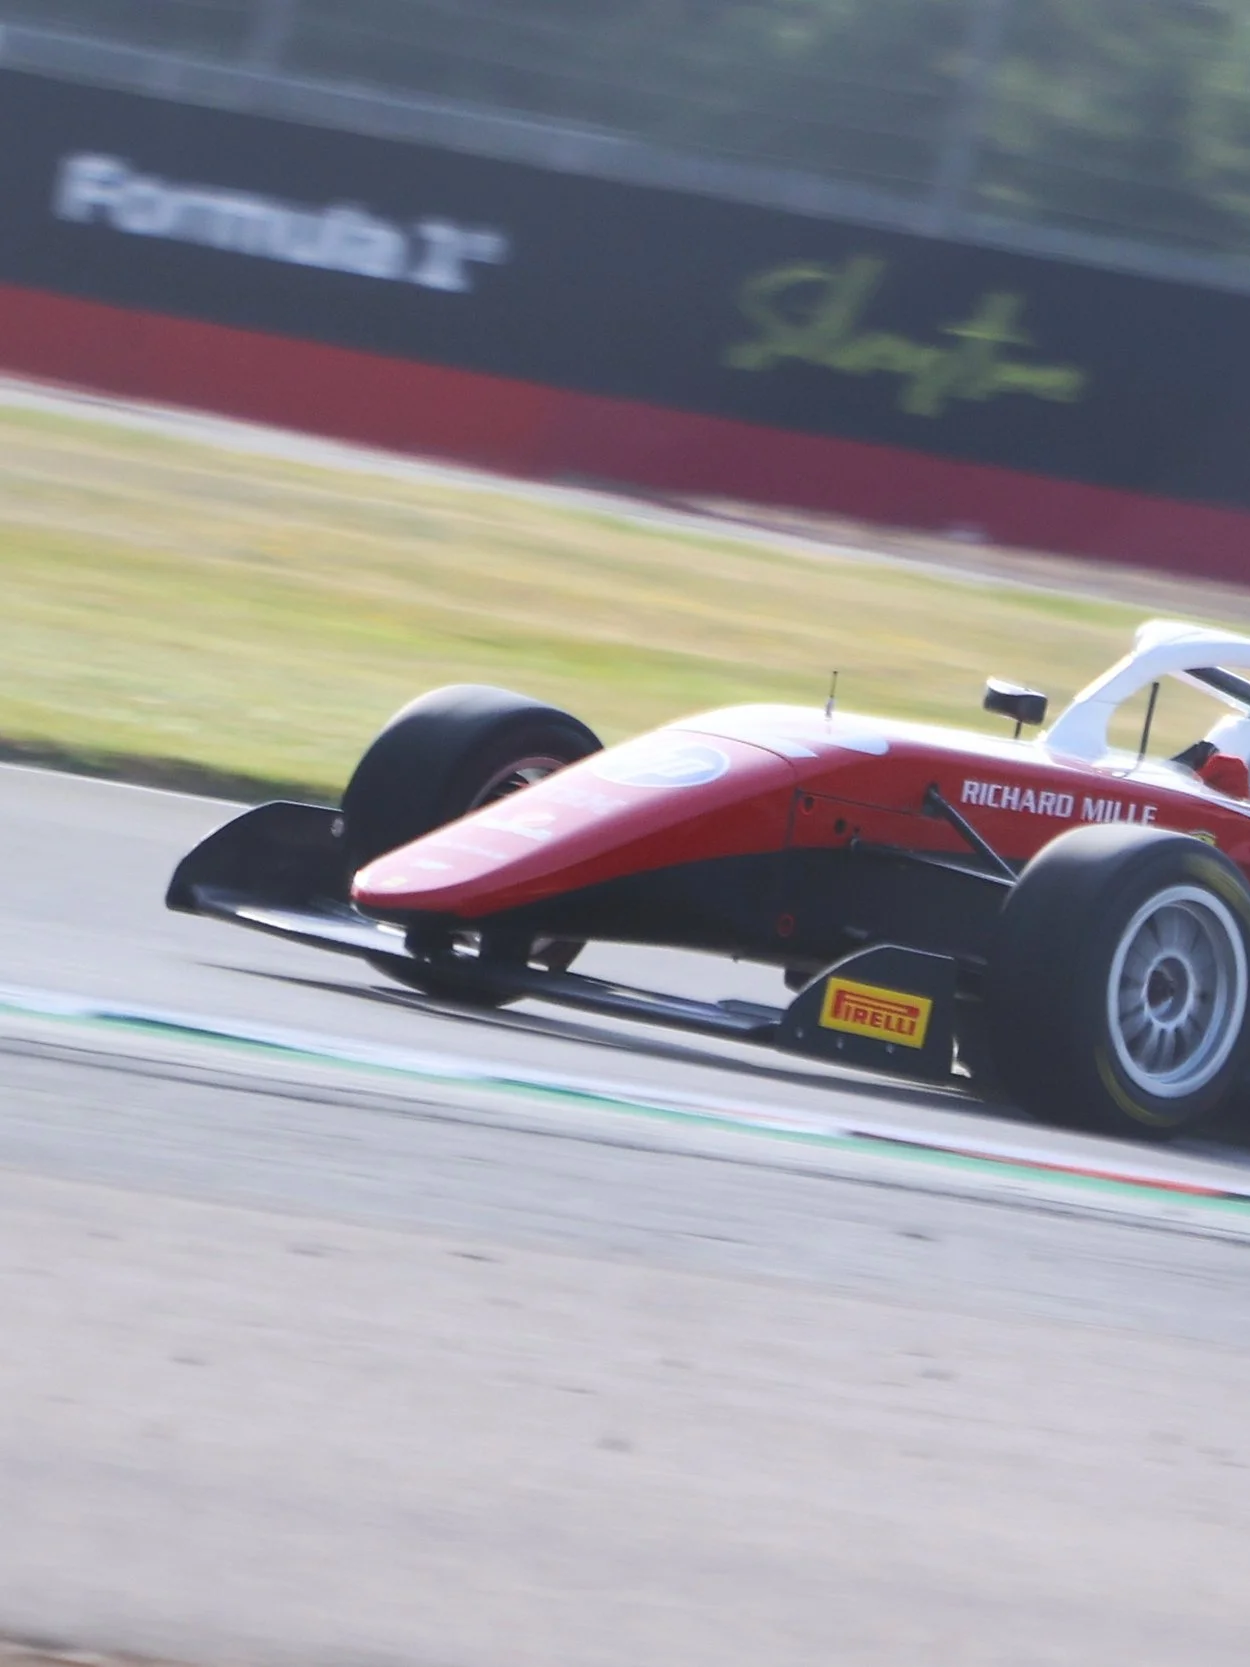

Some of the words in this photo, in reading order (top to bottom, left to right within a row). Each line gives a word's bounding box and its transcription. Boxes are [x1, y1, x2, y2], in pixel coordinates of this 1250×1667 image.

[55, 153, 404, 281] Formula
[961, 780, 1075, 819] RICHARD
[1080, 797, 1158, 826] MILLE
[832, 989, 920, 1036] PIRELLI
